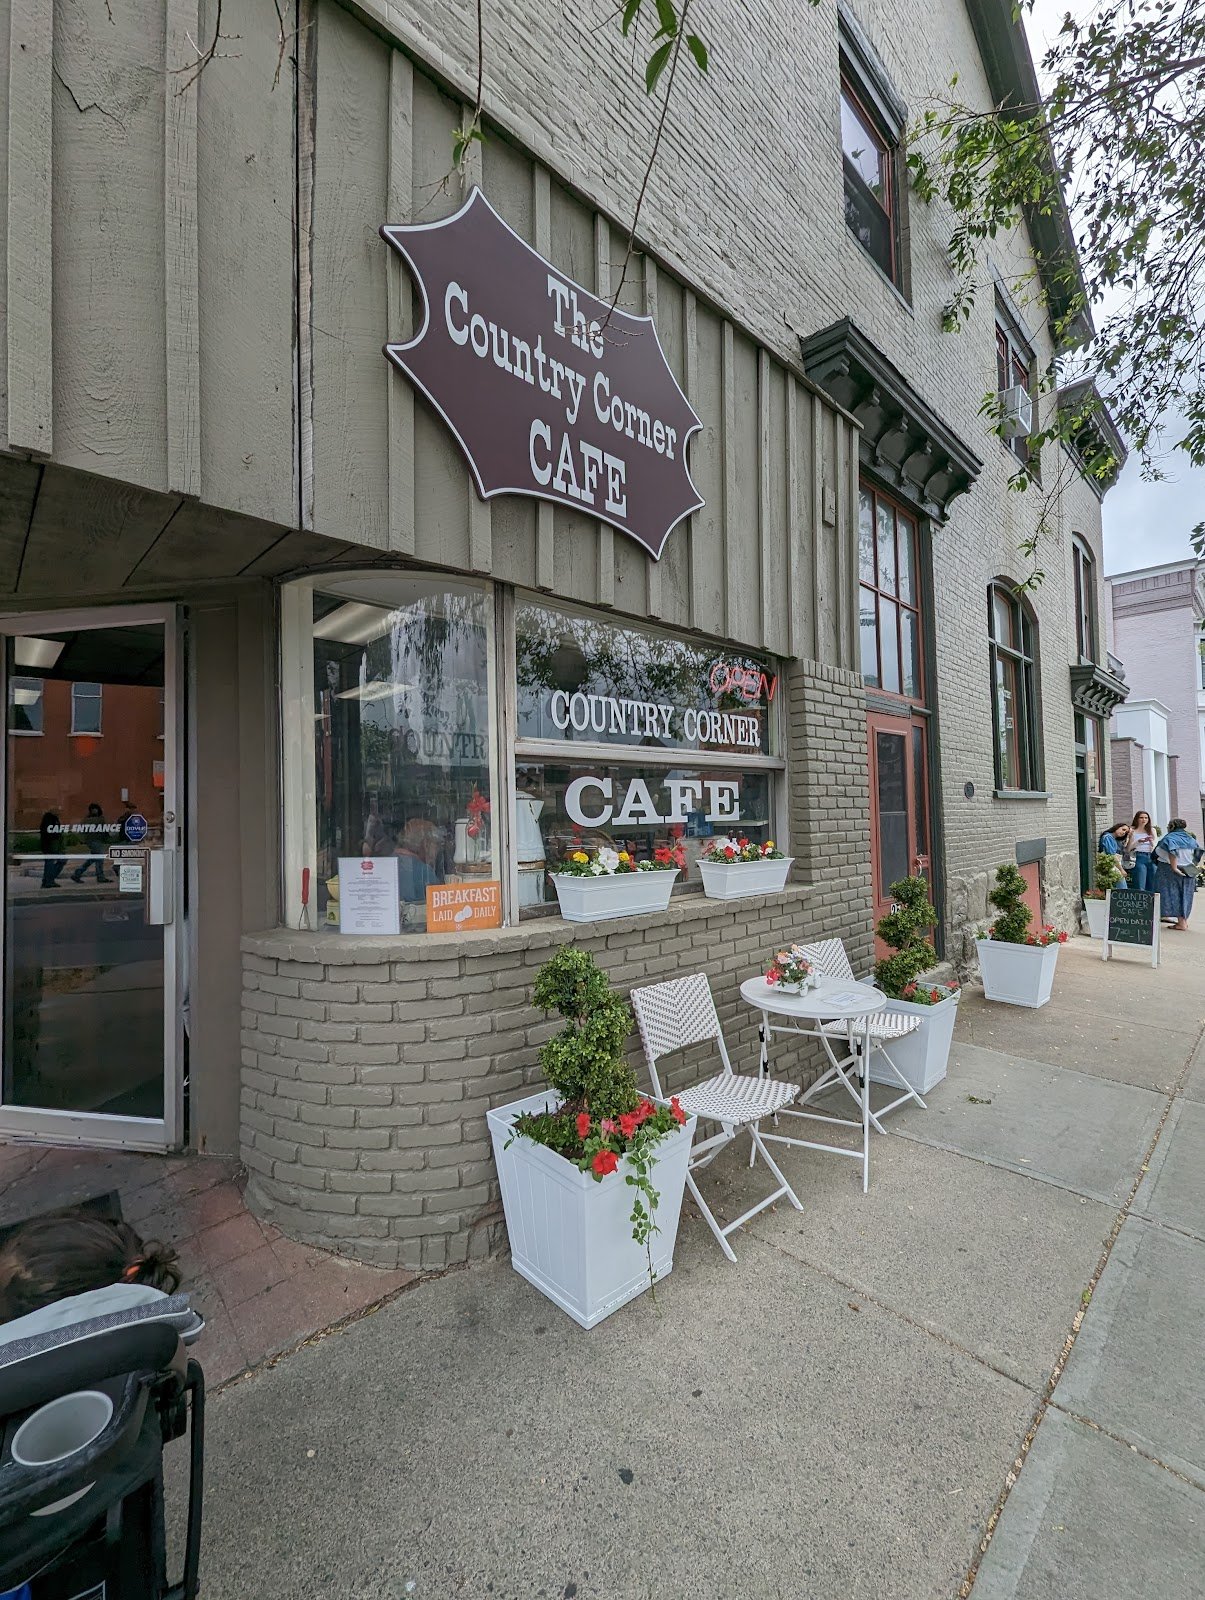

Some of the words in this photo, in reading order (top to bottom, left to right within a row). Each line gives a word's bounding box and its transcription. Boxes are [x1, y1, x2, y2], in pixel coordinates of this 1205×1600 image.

[547, 274, 604, 359] The
[444, 281, 586, 425] Country
[593, 371, 677, 460] Corner
[529, 418, 627, 518] CAFE
[710, 662, 777, 701] OPEN
[551, 689, 675, 739] COUNTRY
[683, 708, 761, 748] CORNER
[564, 776, 740, 828] CAFE
[47, 824, 69, 833] CAFE
[72, 823, 122, 833] ENTRANCE
[111, 849, 120, 858] NO
[121, 849, 146, 858] SMOKIN
[432, 886, 497, 908] BREAKFAST
[1111, 891, 1154, 902] COUNTRY
[1116, 900, 1149, 909] CORNER
[433, 910, 453, 922] LAID
[474, 906, 497, 918] DAILY
[1121, 908, 1143, 916] CAFE
